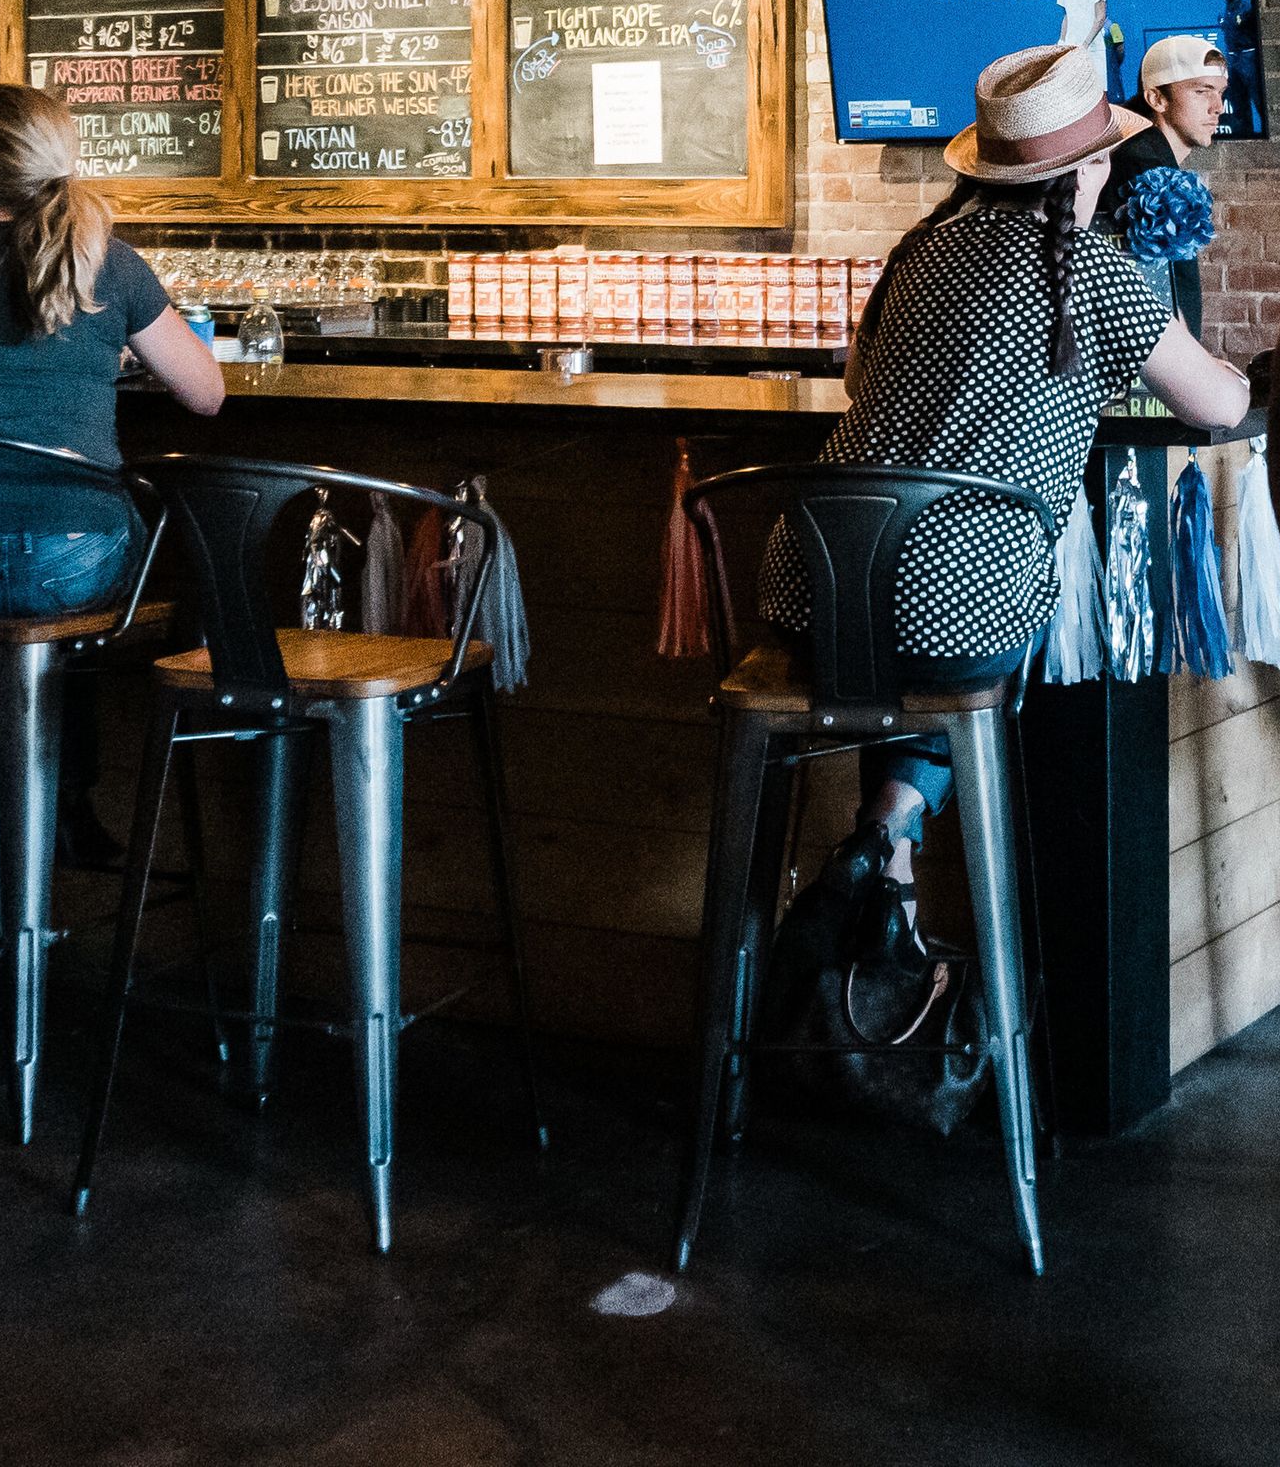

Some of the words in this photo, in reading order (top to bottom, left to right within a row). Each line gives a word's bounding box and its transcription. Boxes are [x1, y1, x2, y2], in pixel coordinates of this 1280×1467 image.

[316, 10, 373, 31] SAISON
[544, 6, 603, 31] TIGHT
[612, 3, 664, 29] ROPE
[565, 27, 648, 50] BALANCED
[656, 24, 692, 48] IPA
[54, 57, 128, 84] RASPBERRY
[131, 56, 183, 83] BREEZE
[66, 85, 126, 105] RASPBERRY
[131, 83, 180, 103] BERLINER
[284, 73, 322, 99] HERE
[325, 72, 374, 96] COMES
[377, 71, 405, 94] THE
[408, 69, 437, 94] SUN
[310, 96, 377, 117] BERLINER
[383, 95, 440, 116] WEISSE
[119, 112, 170, 136] CROWN
[80, 139, 131, 157] ELGIAN
[137, 136, 184, 156] TRIPEL
[284, 125, 356, 151] TARTAN
[311, 150, 370, 170] SCOTCH
[376, 147, 408, 170] ALE
